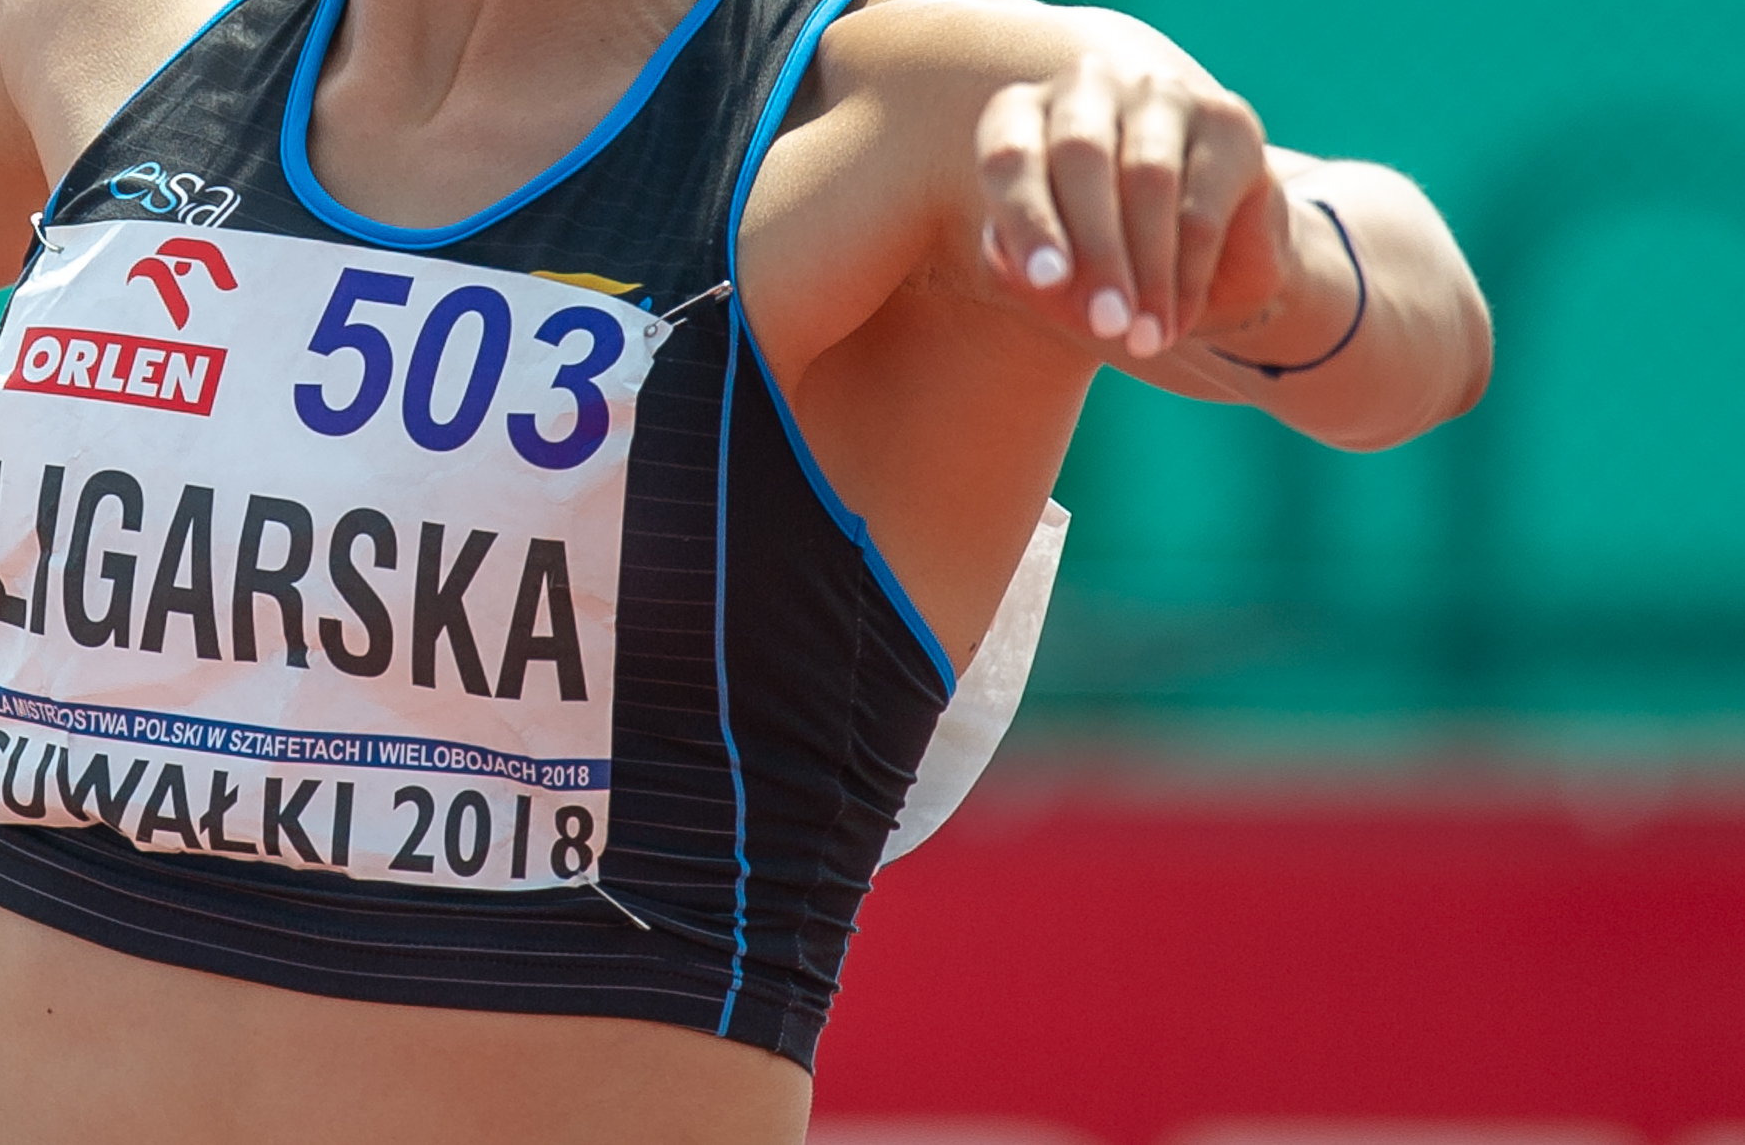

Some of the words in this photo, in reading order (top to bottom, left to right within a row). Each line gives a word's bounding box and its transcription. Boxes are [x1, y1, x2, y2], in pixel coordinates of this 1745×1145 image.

[21, 339, 212, 404] ORLEN
[293, 266, 626, 471] 503
[133, 715, 204, 748] POLSKI
[206, 725, 228, 750] W
[228, 729, 357, 762] SZTAFETACH
[366, 740, 374, 763] I
[378, 741, 537, 783] WIELOBOJACH
[541, 765, 591, 787] 2018
[387, 784, 594, 881] 2018
